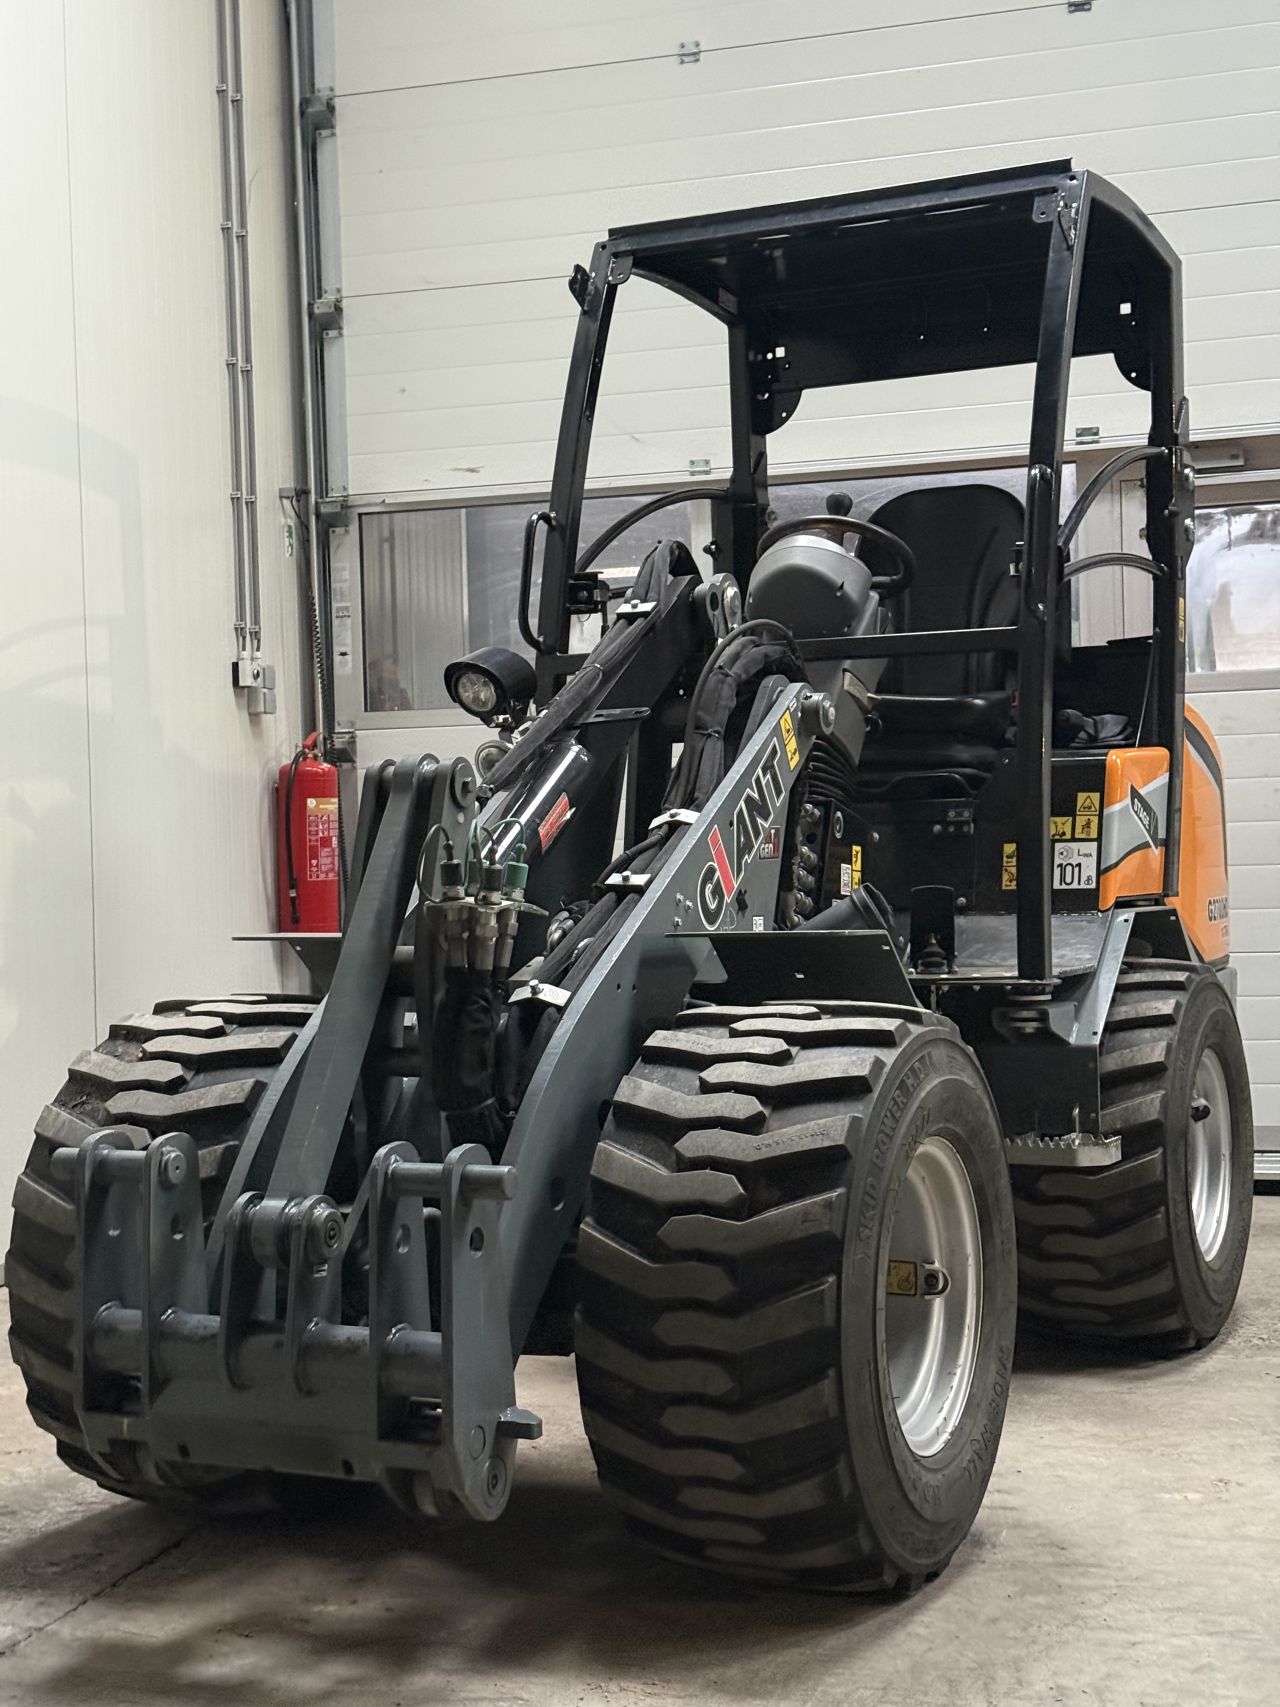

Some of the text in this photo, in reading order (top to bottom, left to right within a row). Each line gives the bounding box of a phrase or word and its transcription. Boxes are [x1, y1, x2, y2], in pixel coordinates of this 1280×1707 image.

[698, 737, 785, 931] GIANT
[1133, 798, 1150, 830] STAGE
[1056, 862, 1094, 886] 101 dB
[858, 1180, 878, 1244] SKID
[872, 1090, 908, 1171] POWER
